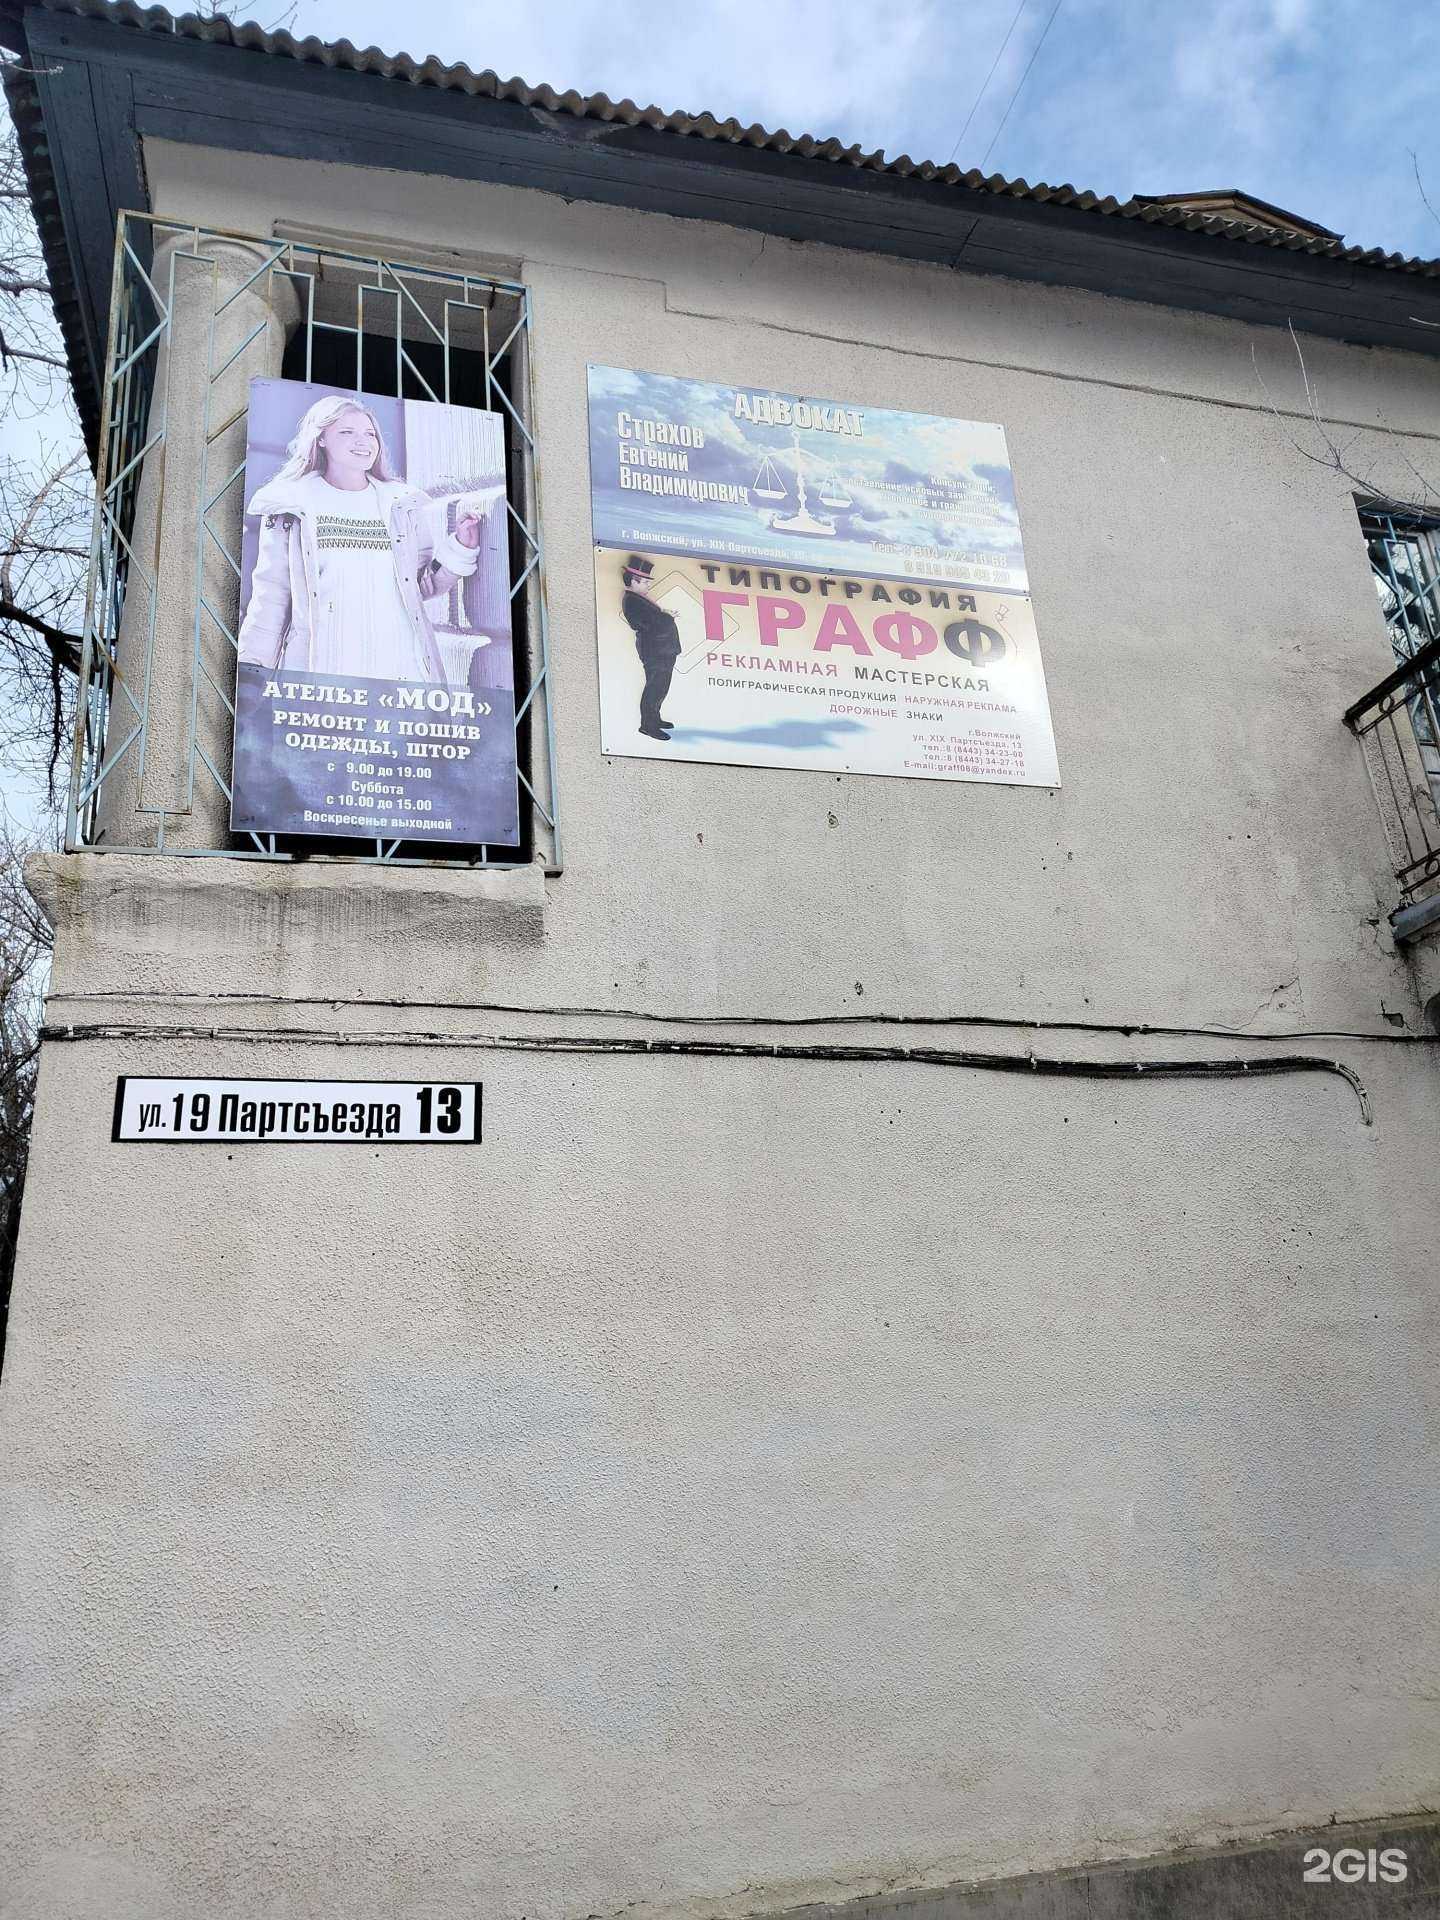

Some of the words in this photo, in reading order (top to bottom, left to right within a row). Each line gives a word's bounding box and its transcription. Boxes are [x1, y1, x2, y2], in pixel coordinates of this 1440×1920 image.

[618, 411, 705, 449] Страхов
[735, 393, 864, 438] АДВОКАТ
[619, 442, 689, 472] Евгений
[620, 466, 749, 505] Владимирович
[621, 530, 630, 538] г.
[701, 564, 978, 612] ТИПОГРАФИЯ
[702, 589, 1006, 667] ГРАФФ
[706, 652, 838, 677] РЕКЛАМНАЯ
[855, 666, 990, 692] МАСТЕРСКАЯ
[262, 680, 369, 706] АТЕЛЬЕ
[378, 687, 492, 718] «МОД»
[708, 677, 826, 696] ПОЛИГРАФИЧЕСКАЯ
[829, 688, 897, 702] ПРОДУКЦИЯ
[905, 696, 965, 708] НАРУЖНАЯ
[967, 702, 1017, 713] РЕКЛАМА
[272, 710, 367, 732] РЕМОНТ
[374, 719, 391, 734] И
[398, 721, 481, 740] ПОШИВ
[830, 704, 898, 718] ДОРОЖНЫЕ
[906, 710, 943, 722] ЗНАКИ
[285, 732, 399, 759] ОДЕЖДЫ,
[406, 742, 471, 760] ШТОР
[327, 763, 335, 772] с
[346, 762, 374, 775] 9.00
[378, 766, 393, 777] до
[397, 766, 432, 778] 19.00
[326, 795, 334, 805] с
[338, 795, 374, 808] 10.00
[377, 799, 393, 810] до
[397, 799, 432, 811] 15.00
[351, 780, 404, 796] Суббота
[303, 810, 387, 827] Воскресенье
[391, 818, 452, 830] выходной
[138, 1102, 166, 1132] ул.
[173, 1093, 211, 1132] 19
[218, 1094, 400, 1138] Партсъезда
[416, 1087, 462, 1134] 13
